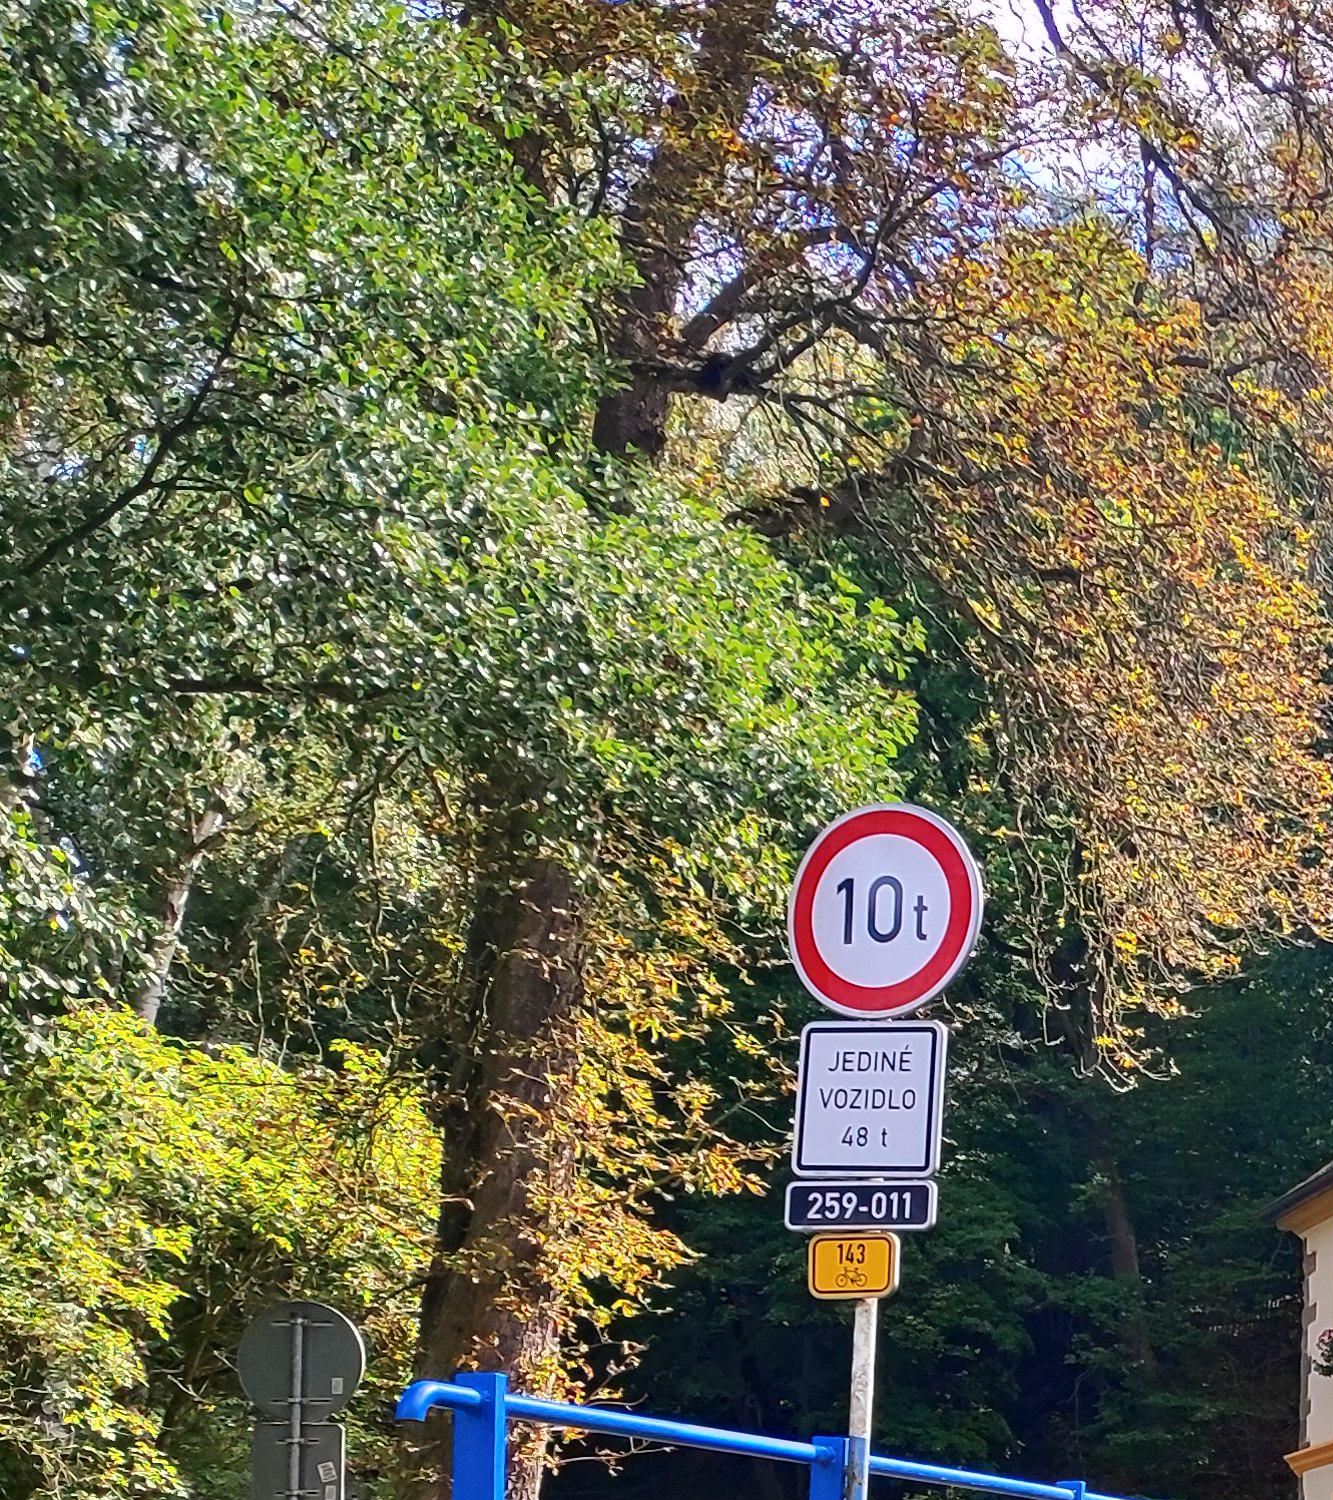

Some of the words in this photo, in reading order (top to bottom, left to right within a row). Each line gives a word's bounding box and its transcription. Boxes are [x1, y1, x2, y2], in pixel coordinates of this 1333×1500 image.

[827, 1044, 913, 1073] JEDINÉ
[819, 1087, 917, 1110] VOZIDLO
[841, 1126, 869, 1147] 48
[881, 1127, 888, 1147] t
[806, 1191, 912, 1220] 259-011
[836, 1243, 867, 1265] 143
